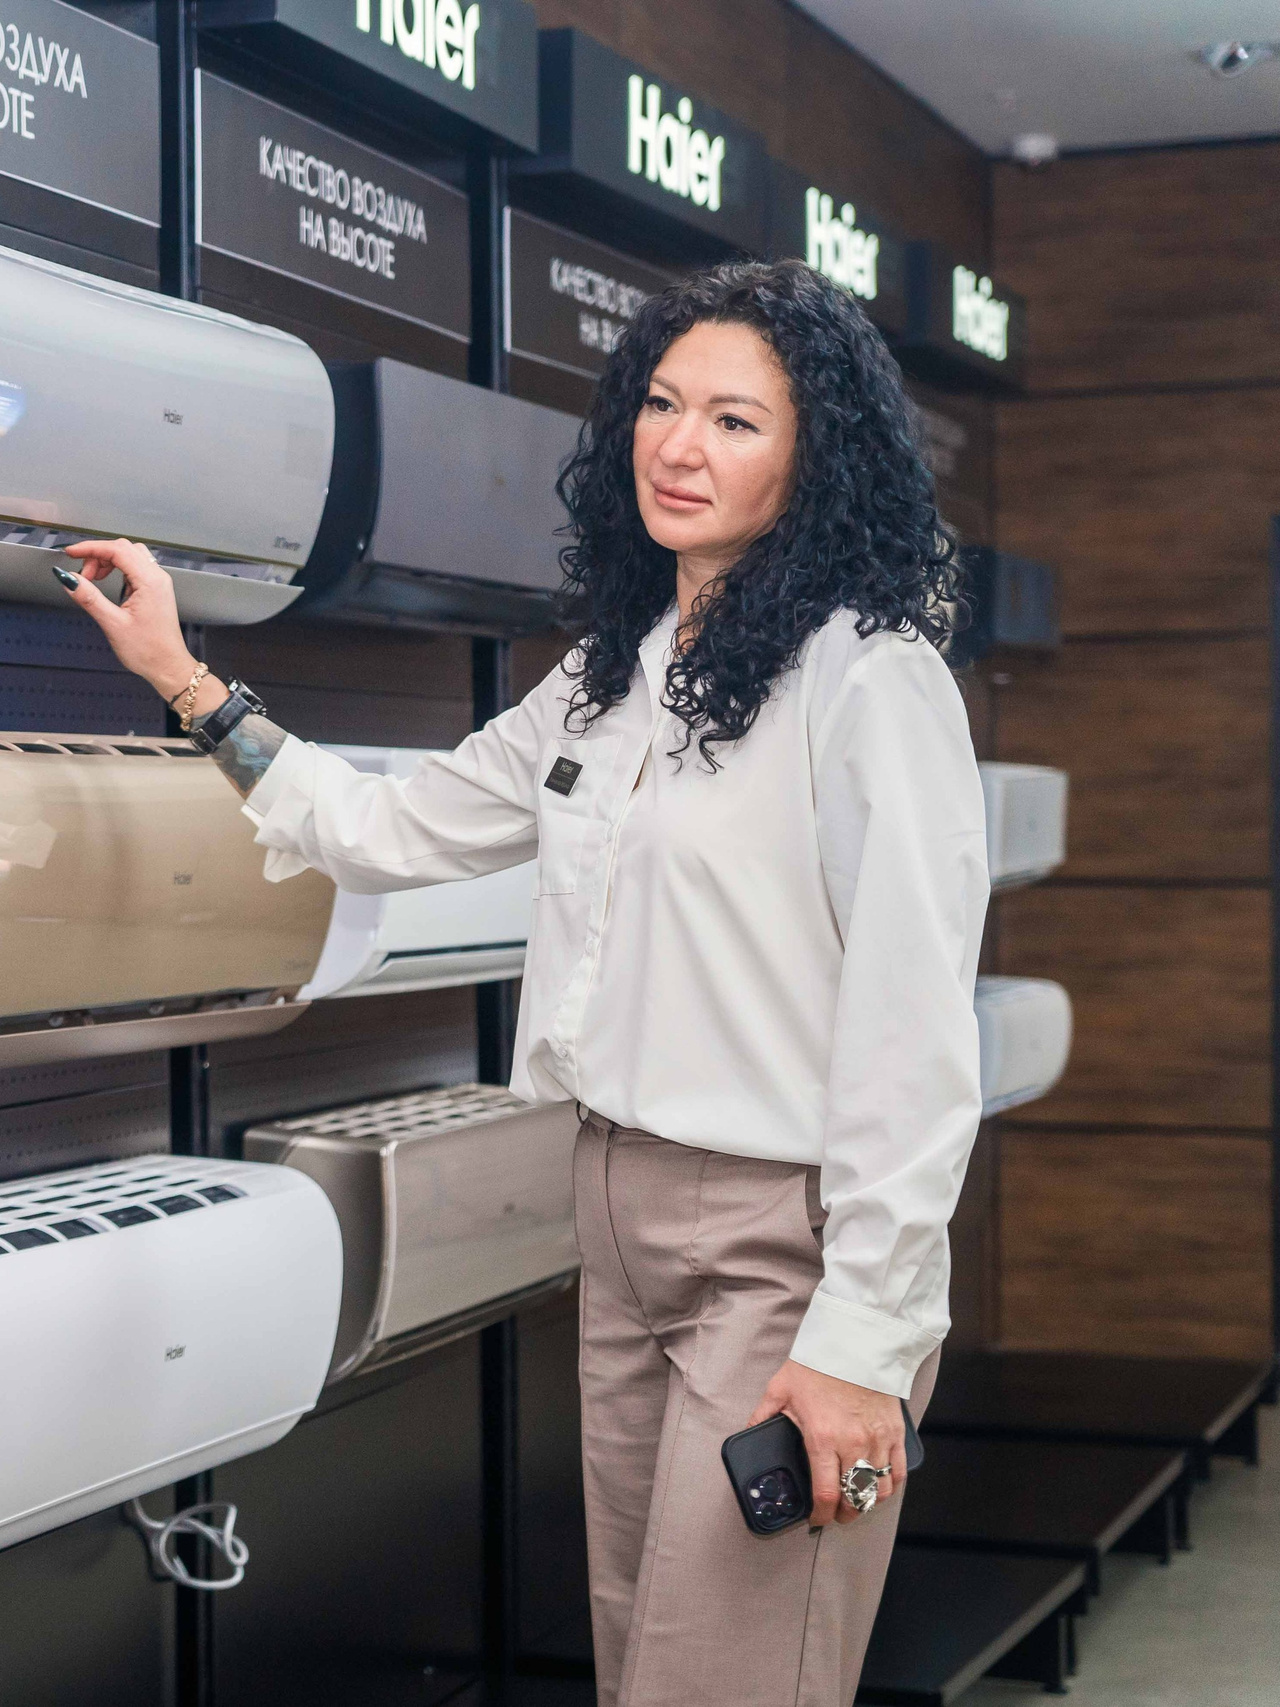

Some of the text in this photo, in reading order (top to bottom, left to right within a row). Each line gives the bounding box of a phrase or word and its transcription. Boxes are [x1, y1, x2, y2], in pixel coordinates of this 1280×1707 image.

[259, 135, 427, 244] КАЧЕСТВО ВОЗДУХА
[627, 74, 724, 212] Haier
[299, 205, 395, 279] НА ВЫСОТЕ
[806, 187, 879, 300] Haier
[953, 265, 1009, 361] Haier
